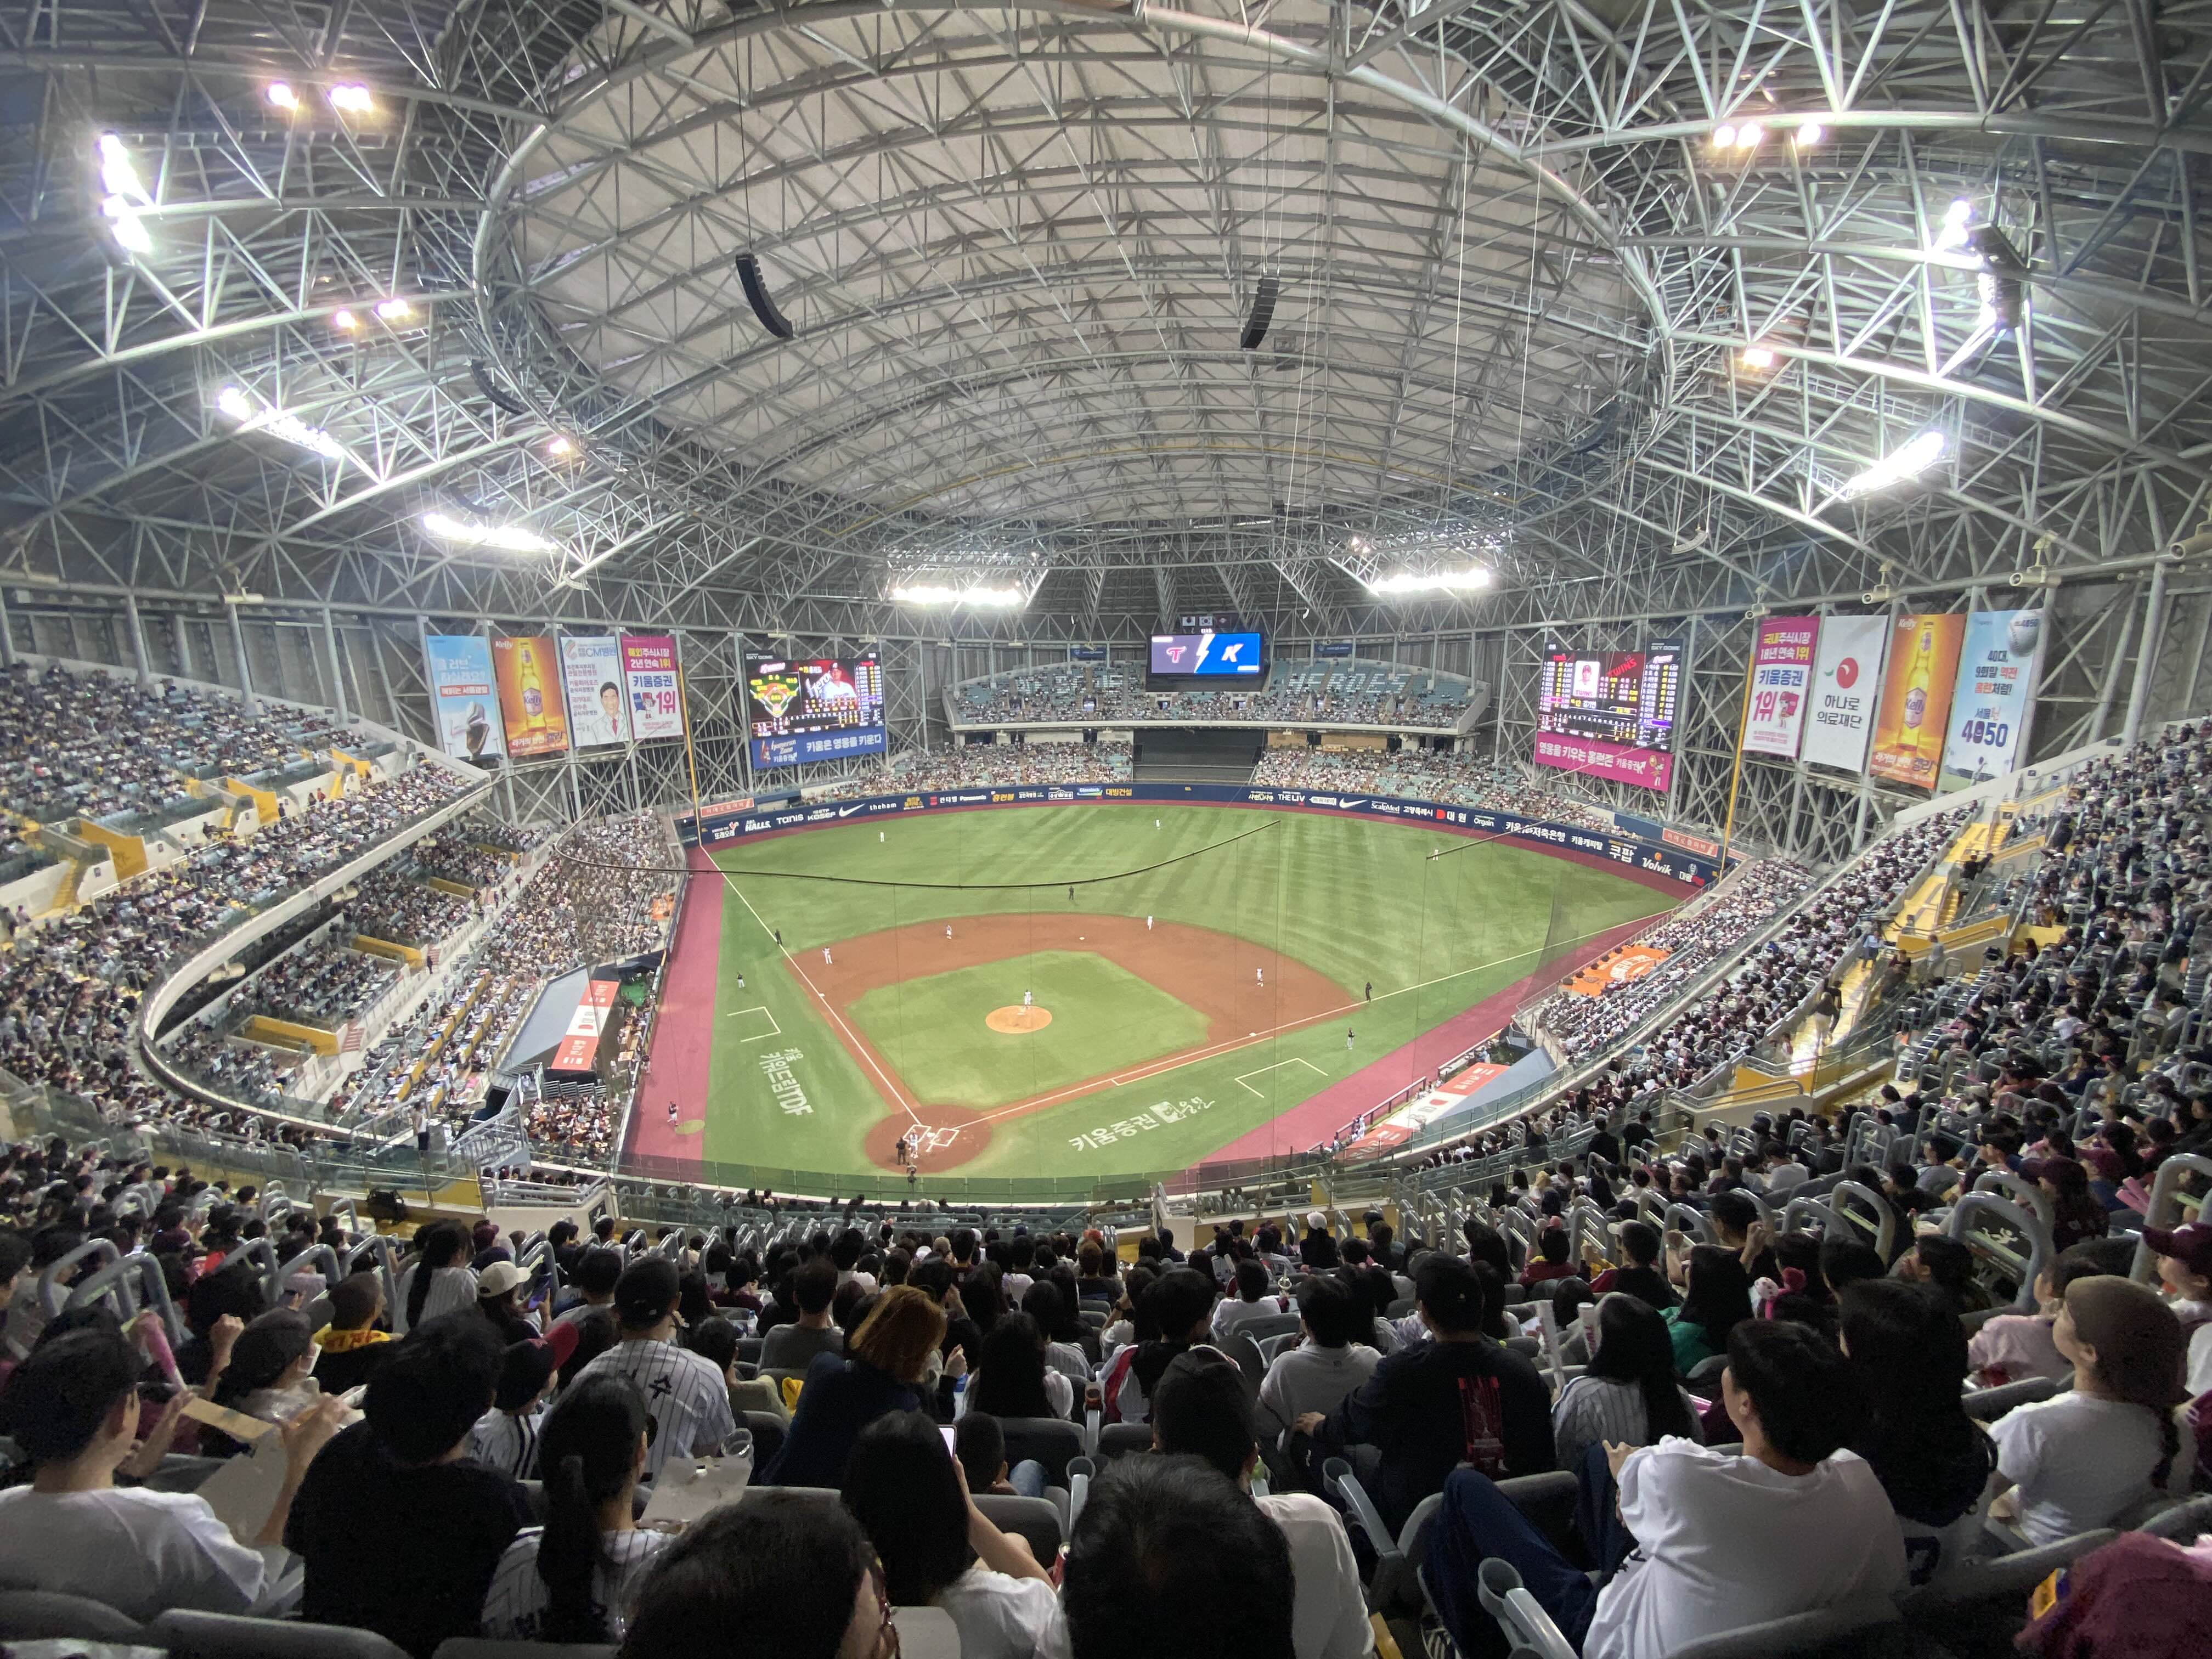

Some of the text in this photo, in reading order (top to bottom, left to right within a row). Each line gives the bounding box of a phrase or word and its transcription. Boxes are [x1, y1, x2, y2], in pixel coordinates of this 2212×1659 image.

[1898, 618, 1918, 629] Kelly
[1764, 632, 1810, 644] 국내주식시장
[495, 640, 514, 650] Kelly
[628, 648, 669, 657] 해외주식시장
[1760, 647, 1809, 660] 18년 연속 1위
[631, 658, 672, 668] 2년 연속 1위
[1758, 669, 1804, 686] 키움증권
[1975, 666, 1998, 678] 9회말
[633, 675, 673, 687] 키움증권
[523, 696, 541, 706] Kelly
[656, 691, 676, 714] 1위
[1753, 691, 1778, 721] 1위
[1825, 695, 1860, 710] 하나로
[1905, 698, 1925, 714] Kelly
[1816, 711, 1862, 729] 의료재단
[1962, 720, 2008, 747] 4050
[806, 733, 882, 753] 키움은 영웅을 키운다
[1539, 742, 1561, 757] 영웅을
[1562, 746, 1586, 762] 키우는
[870, 803, 897, 811] theham
[1371, 802, 1400, 812] ScalpMed
[1403, 806, 1433, 816] 고양특례시
[745, 821, 771, 832] HALLS
[1474, 817, 1494, 827] Orgain
[1571, 836, 1603, 850] 키움캐피탈
[1642, 857, 1672, 876] Volvik
[784, 1047, 804, 1062] 키움
[1069, 1113, 1160, 1151] 키움증권
